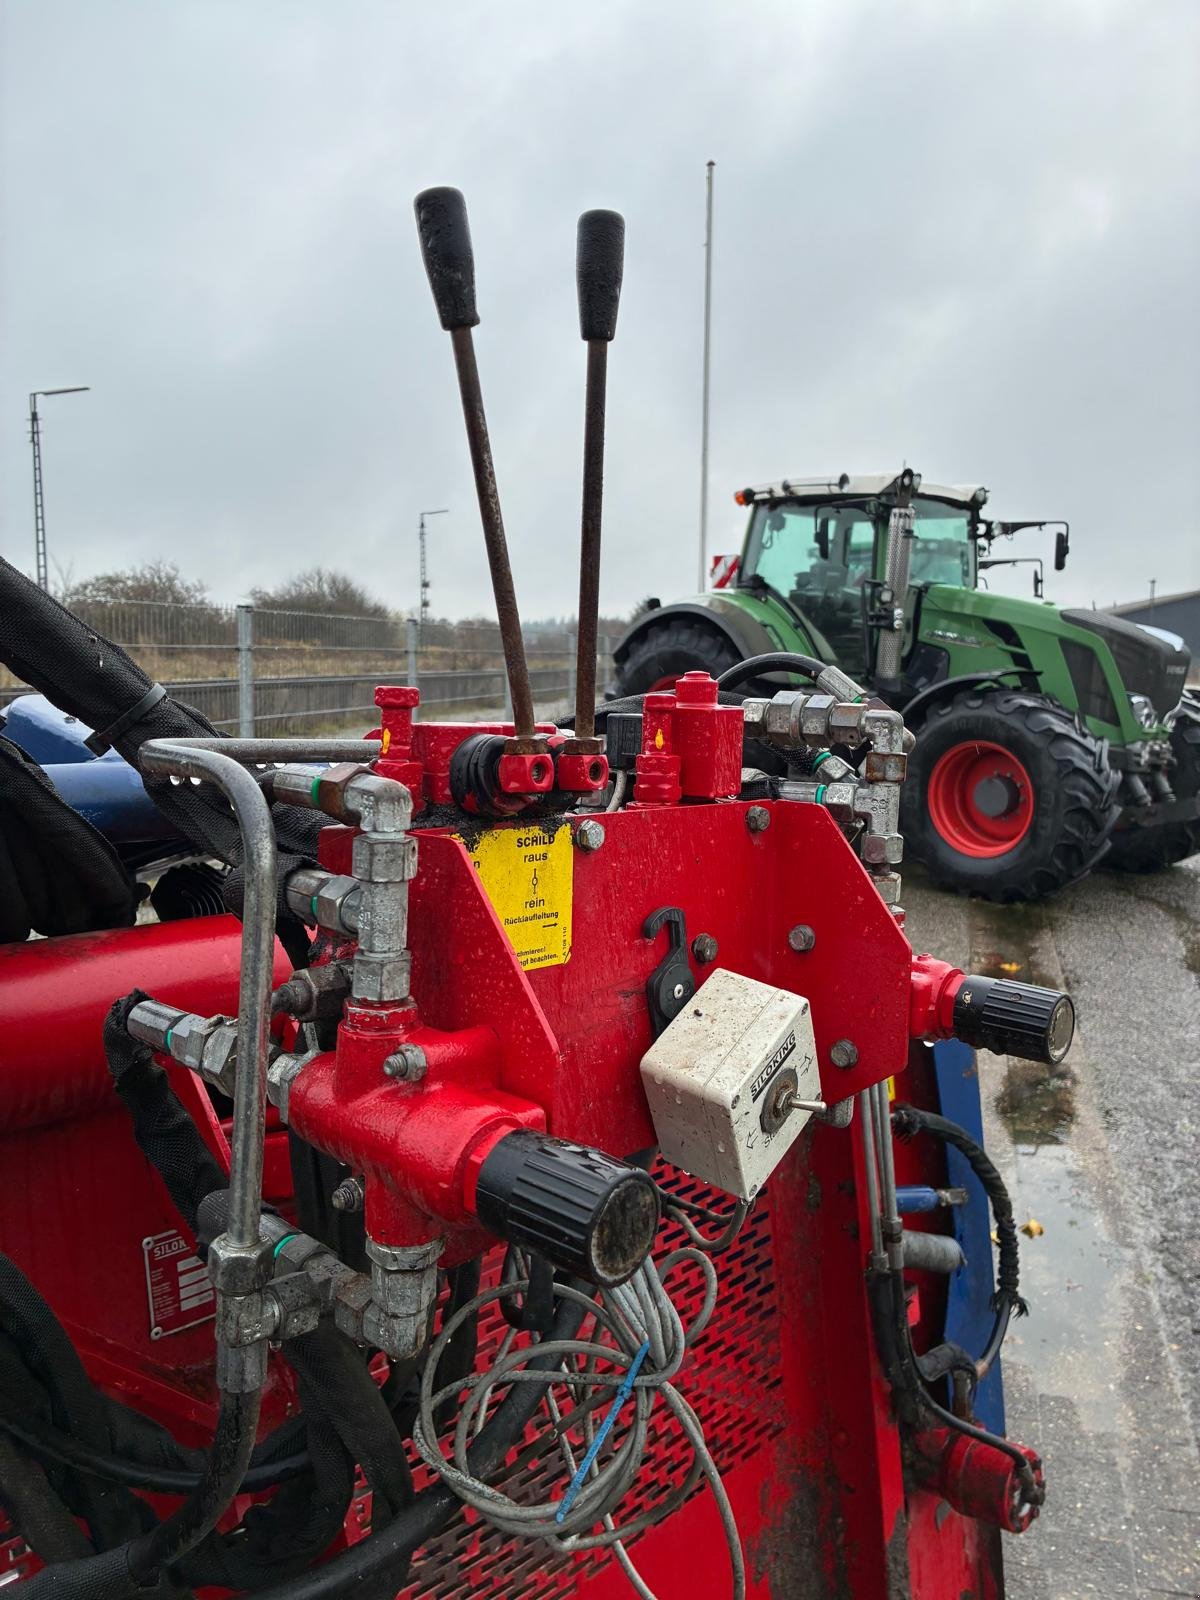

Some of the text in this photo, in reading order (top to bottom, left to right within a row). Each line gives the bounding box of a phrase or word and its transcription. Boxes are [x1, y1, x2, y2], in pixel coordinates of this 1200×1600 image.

[516, 834, 555, 848] SCHILD
[523, 852, 548, 863] raus
[524, 897, 545, 909] rein
[750, 1033, 796, 1097] SILOKING
